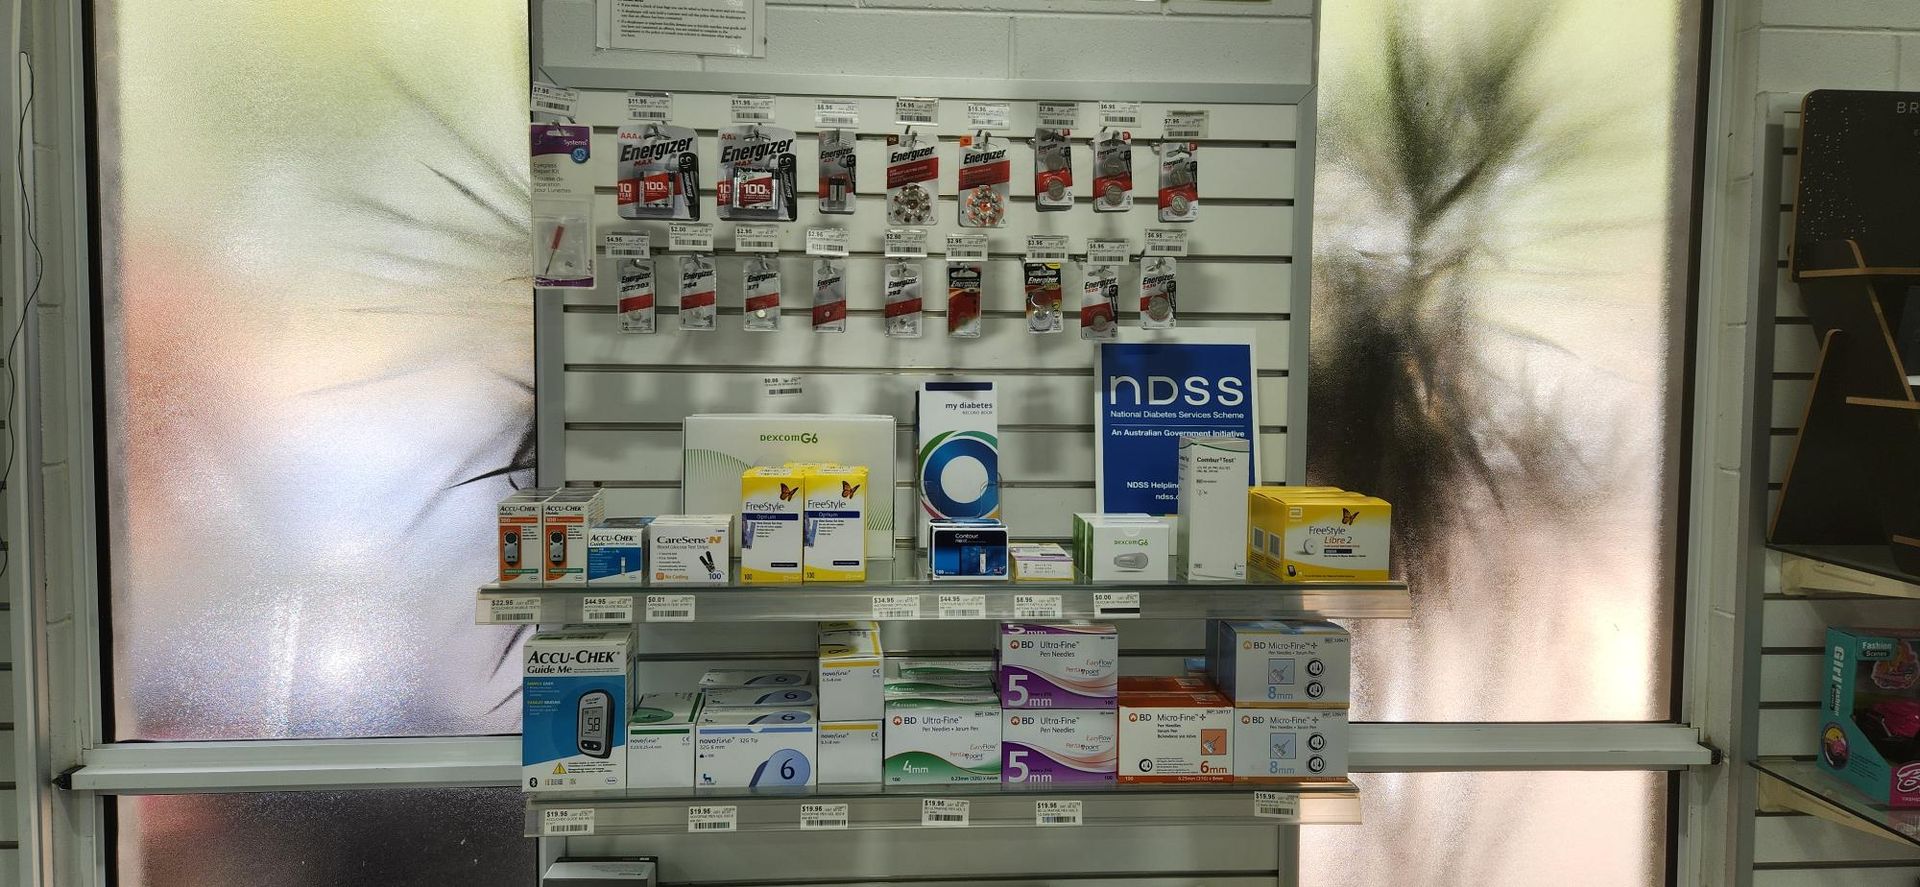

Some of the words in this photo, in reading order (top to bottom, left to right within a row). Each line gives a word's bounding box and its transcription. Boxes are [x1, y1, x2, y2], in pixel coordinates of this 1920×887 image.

[619, 137, 694, 163] Energizer
[720, 138, 794, 164] Energizer
[890, 146, 935, 163] Energizer
[963, 149, 1007, 165] Energizer
[618, 182, 632, 193] 10
[645, 181, 668, 191] 100%
[718, 183, 731, 194] 10
[743, 184, 771, 195] 100%
[621, 271, 652, 283] Energizer
[683, 269, 713, 281] Energizer
[747, 271, 777, 283] Energizer
[1142, 274, 1174, 285] Energizer
[817, 276, 841, 287] Energizer
[888, 277, 917, 288] Energizer
[950, 280, 979, 288] Energizer
[1027, 276, 1059, 285] Energizer
[1084, 277, 1117, 289] Energizer
[945, 402, 957, 411] my
[959, 401, 993, 409] diabetes
[1143, 411, 1177, 419] Diabetes
[1178, 411, 1211, 419] Services
[1212, 411, 1244, 419] Scheme
[1123, 429, 1162, 437] Australian
[1127, 481, 1149, 489] NDSS
[745, 502, 785, 512] FreeStyle
[807, 500, 847, 509] FreeStyle
[1308, 526, 1346, 536] FreeStyle
[590, 534, 634, 542] ACCU-CHEK
[657, 536, 707, 544] CareSens
[708, 536, 722, 544] N
[1324, 535, 1345, 544] Libre
[1346, 536, 1353, 544] 2
[708, 572, 722, 580] 100
[1021, 641, 1034, 649] BD
[1040, 640, 1077, 649] Ultra-Fine
[1253, 642, 1266, 650] BD
[1268, 641, 1306, 650] Micro-Fine
[527, 650, 616, 664] ACCU-CHEK
[527, 665, 555, 674] Guide
[557, 665, 572, 674] Me
[785, 691, 798, 699] 6
[904, 716, 917, 724] BD
[922, 716, 959, 724] Ultra-Fine
[1021, 717, 1034, 725] BD
[1040, 716, 1077, 725] Ultra-Fine
[1139, 713, 1152, 721] BD
[1157, 713, 1196, 721] Micro-Fine
[1252, 716, 1265, 724] BD
[1270, 716, 1307, 724] Micro-Fine
[780, 757, 795, 780] 6
[1255, 792, 1275, 800] $19.95
[546, 810, 568, 818] $19.95
